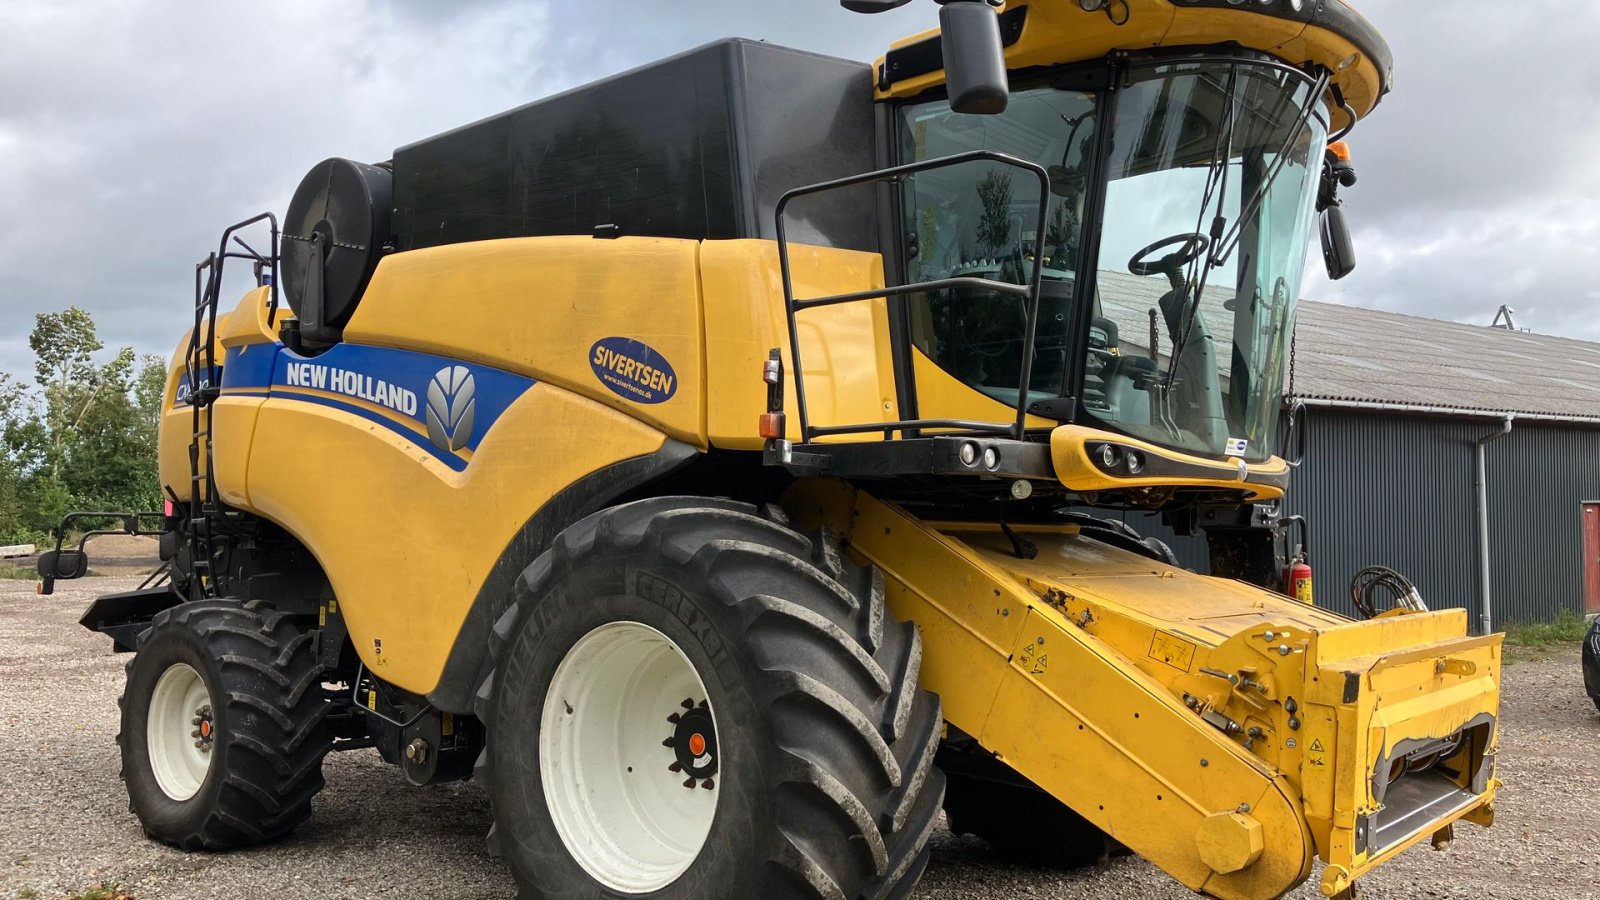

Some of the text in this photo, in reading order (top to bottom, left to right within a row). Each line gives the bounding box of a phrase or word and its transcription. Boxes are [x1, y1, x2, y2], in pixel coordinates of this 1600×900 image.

[287, 363, 417, 416] NEW HOLLAND
[594, 346, 672, 395] SIVERTSEN
